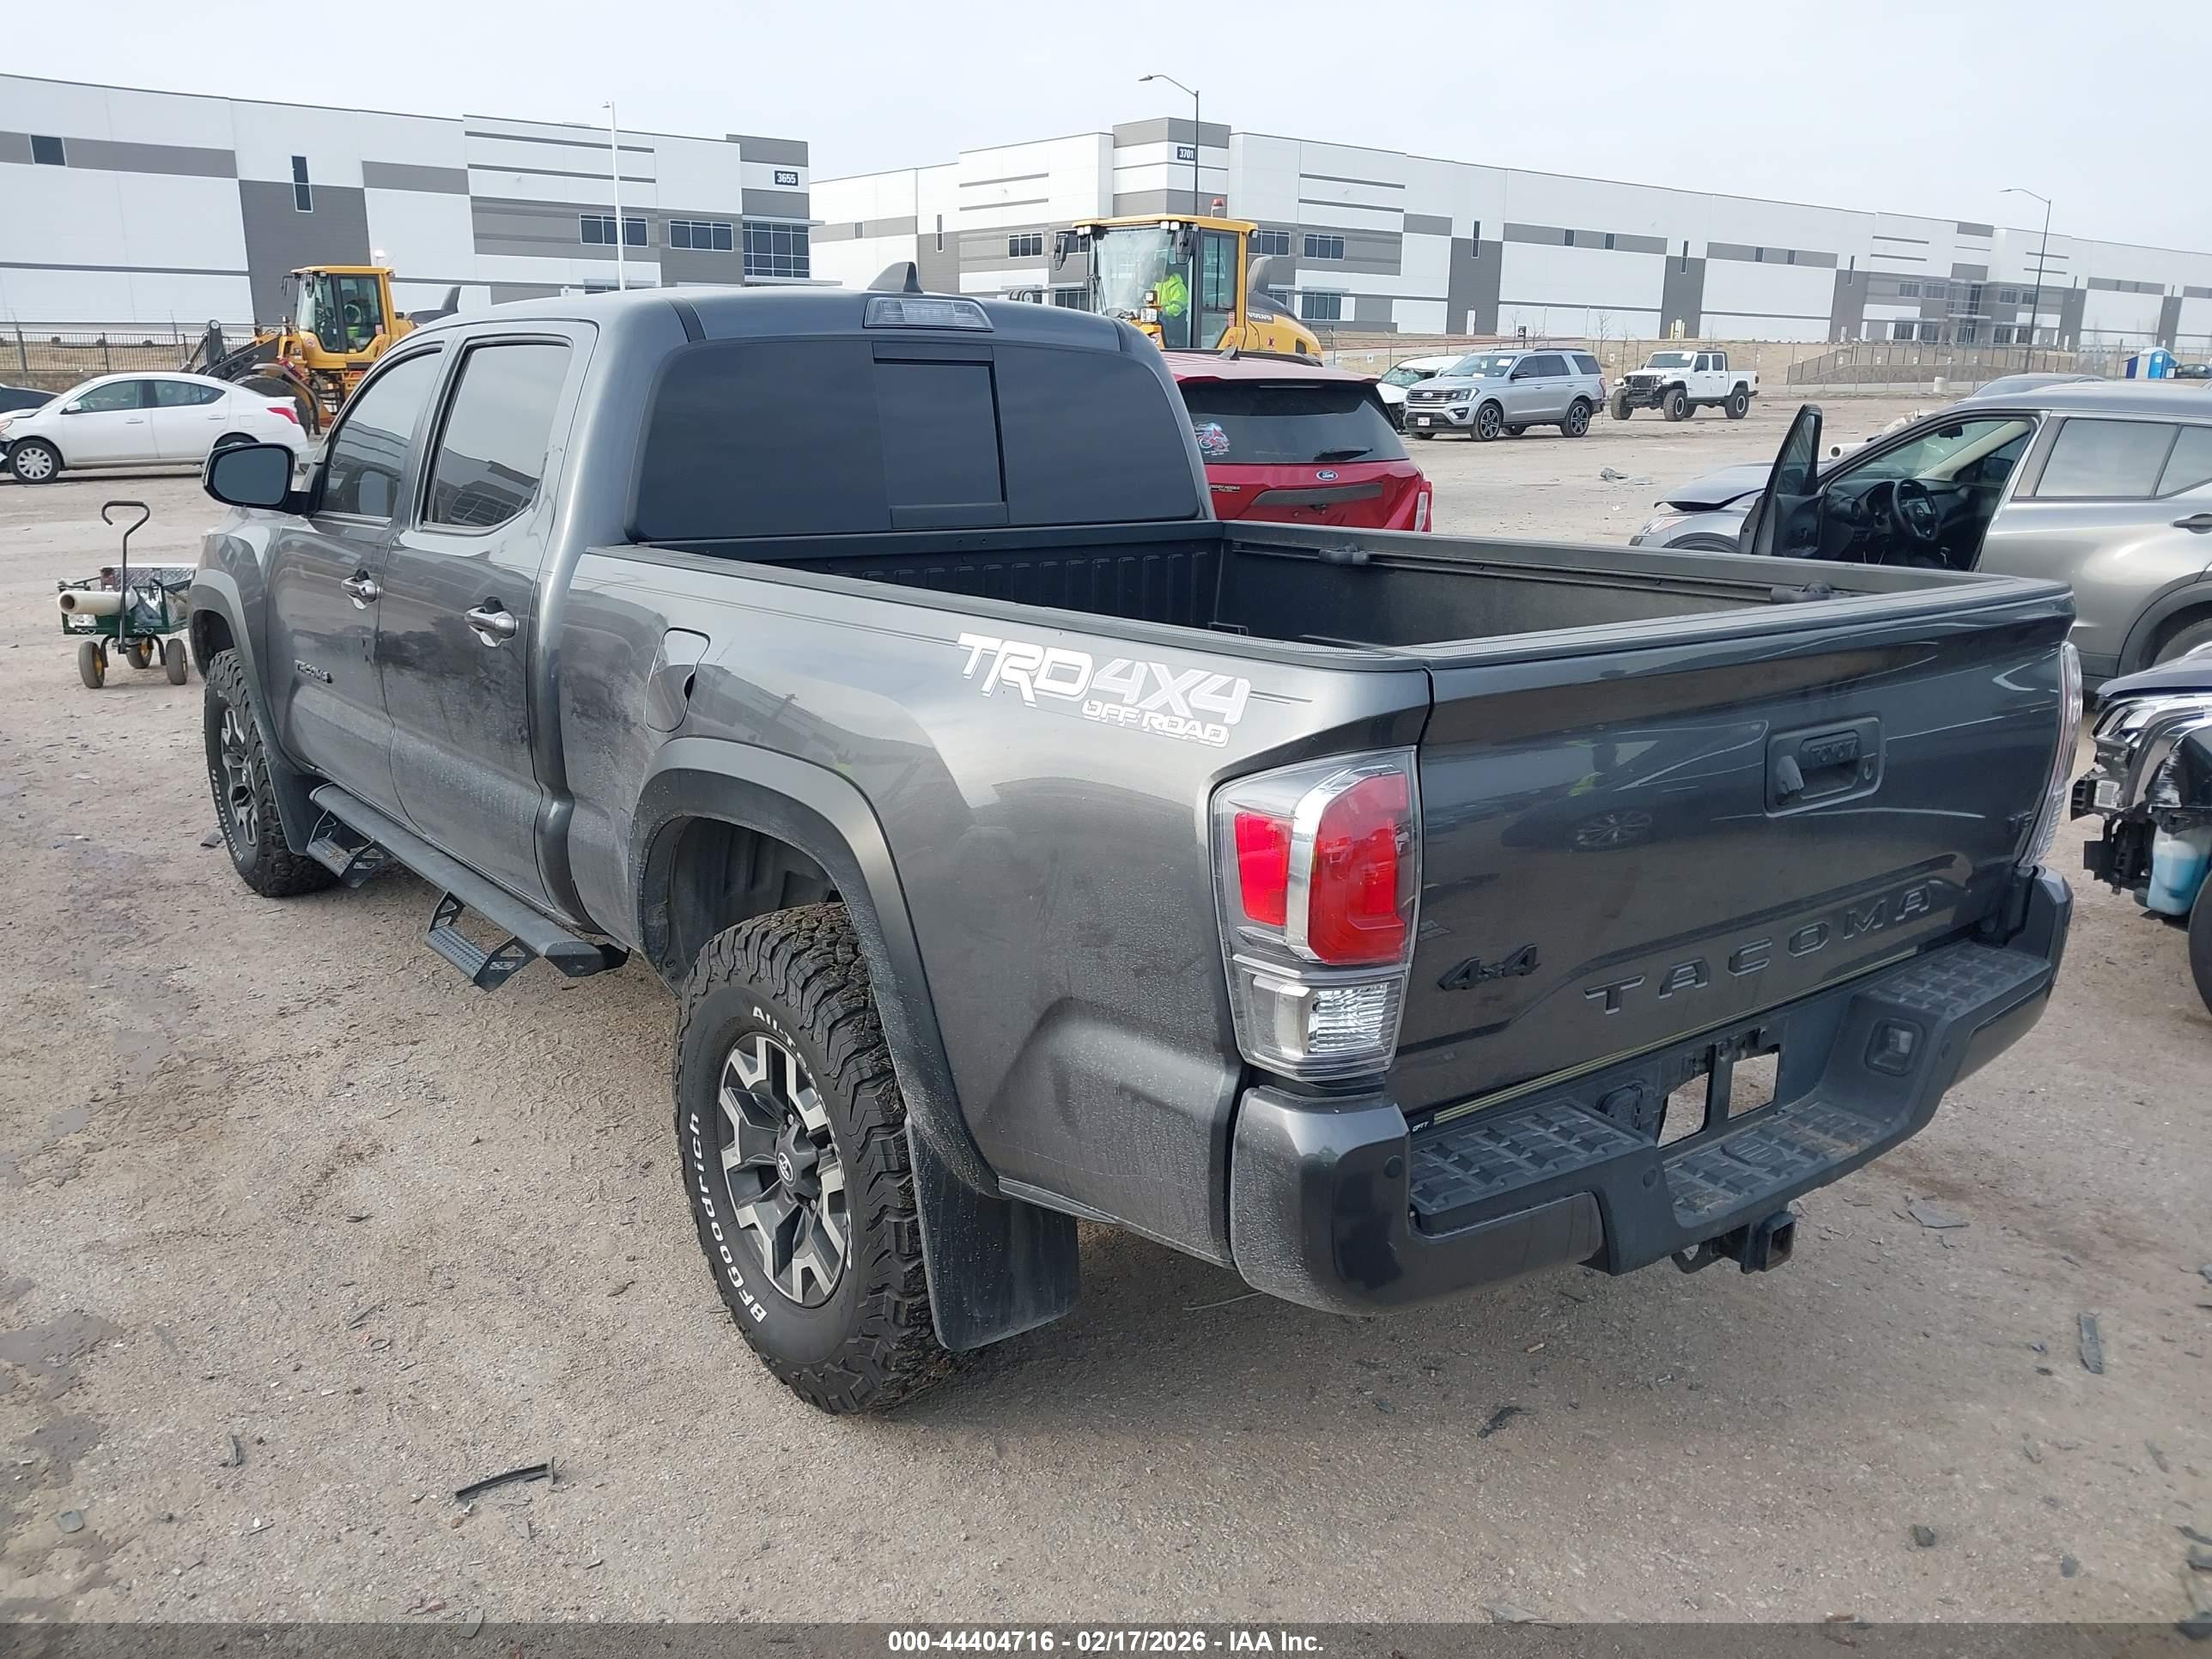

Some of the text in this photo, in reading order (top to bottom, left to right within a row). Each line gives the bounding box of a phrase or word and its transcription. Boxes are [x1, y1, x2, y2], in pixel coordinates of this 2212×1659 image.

[1179, 148, 1194, 160] 3701
[776, 173, 796, 184] 3655
[1247, 312, 1273, 321] VOLVO
[957, 633, 1095, 708] TRD
[1082, 699, 1231, 749] OFF ROAD
[1583, 884, 1933, 1015] TACOMA
